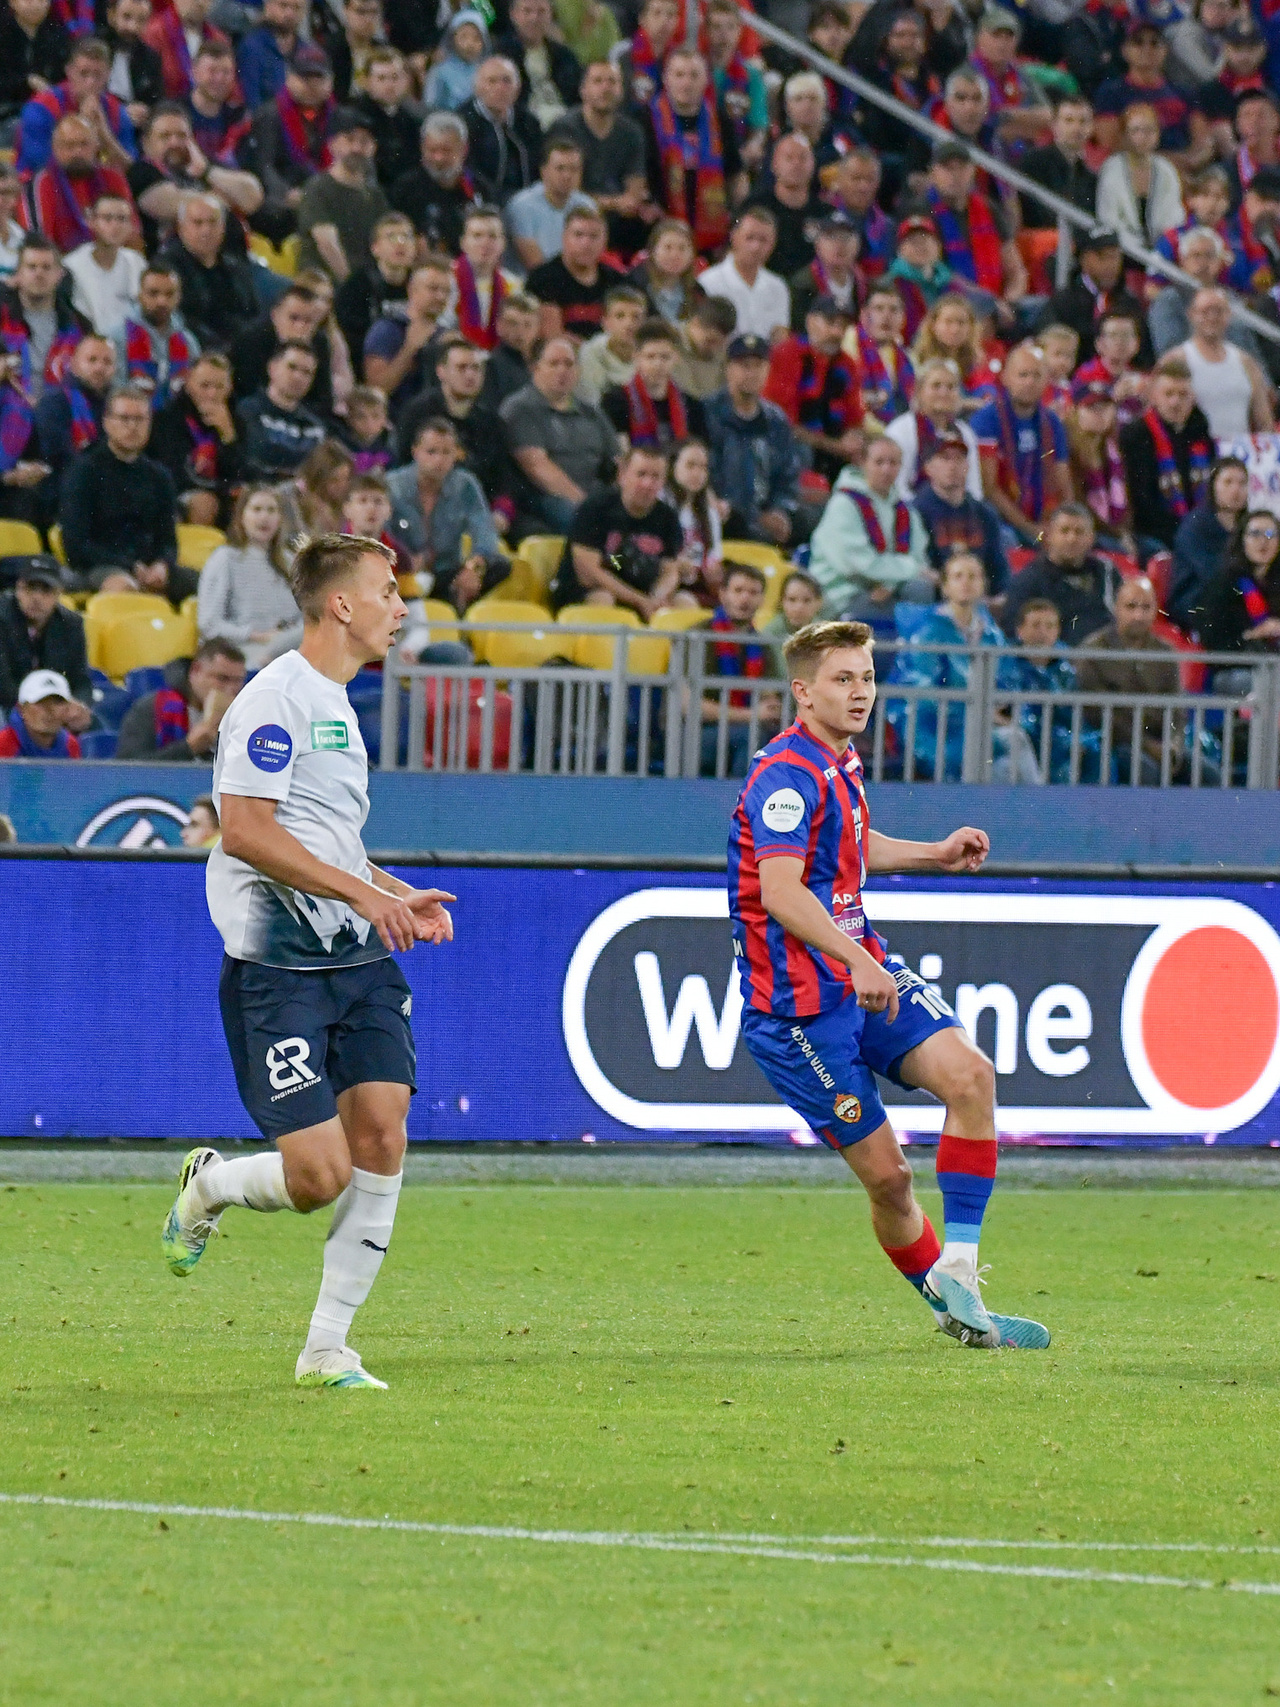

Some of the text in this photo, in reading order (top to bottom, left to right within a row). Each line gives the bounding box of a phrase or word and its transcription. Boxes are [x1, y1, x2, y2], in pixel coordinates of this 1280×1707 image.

[267, 740, 289, 752] МИР
[780, 803, 801, 812] МИР
[810, 1056, 836, 1089] ПОЧТА
[270, 1075, 322, 1102] ENGINEERING
